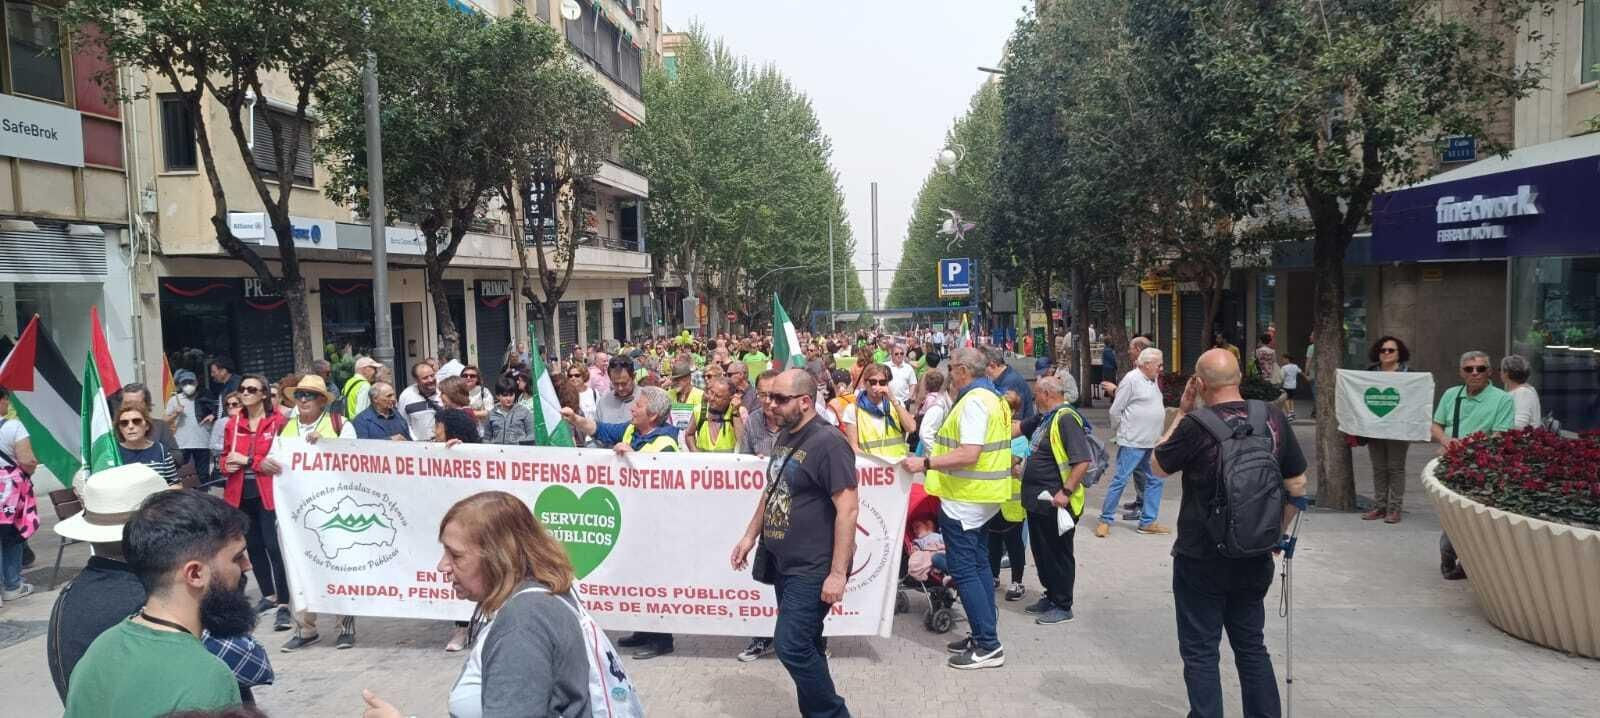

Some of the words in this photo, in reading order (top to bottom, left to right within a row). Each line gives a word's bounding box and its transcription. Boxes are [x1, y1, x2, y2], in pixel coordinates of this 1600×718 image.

[2, 118, 58, 140] SafeBrok
[1436, 185, 1538, 223] finetwork
[948, 263, 962, 281] P
[291, 452, 391, 474] PLATAFORMA
[396, 457, 414, 476] DE
[418, 458, 481, 479] LINARES
[486, 461, 506, 480] EN
[511, 462, 581, 484] DEFENSA
[586, 466, 615, 486] DEL
[619, 467, 685, 489] SISTEMA
[691, 466, 764, 490] PÚBLICO
[541, 511, 615, 529] SERVICIOS
[416, 571, 437, 582] EN
[327, 584, 403, 600] SANIDAD,
[408, 587, 455, 600] PENSI
[579, 583, 668, 598] SERVICIOS
[673, 585, 760, 600] PÚBLICOS
[619, 602, 641, 613] DE
[646, 603, 733, 618] MAYORES,
